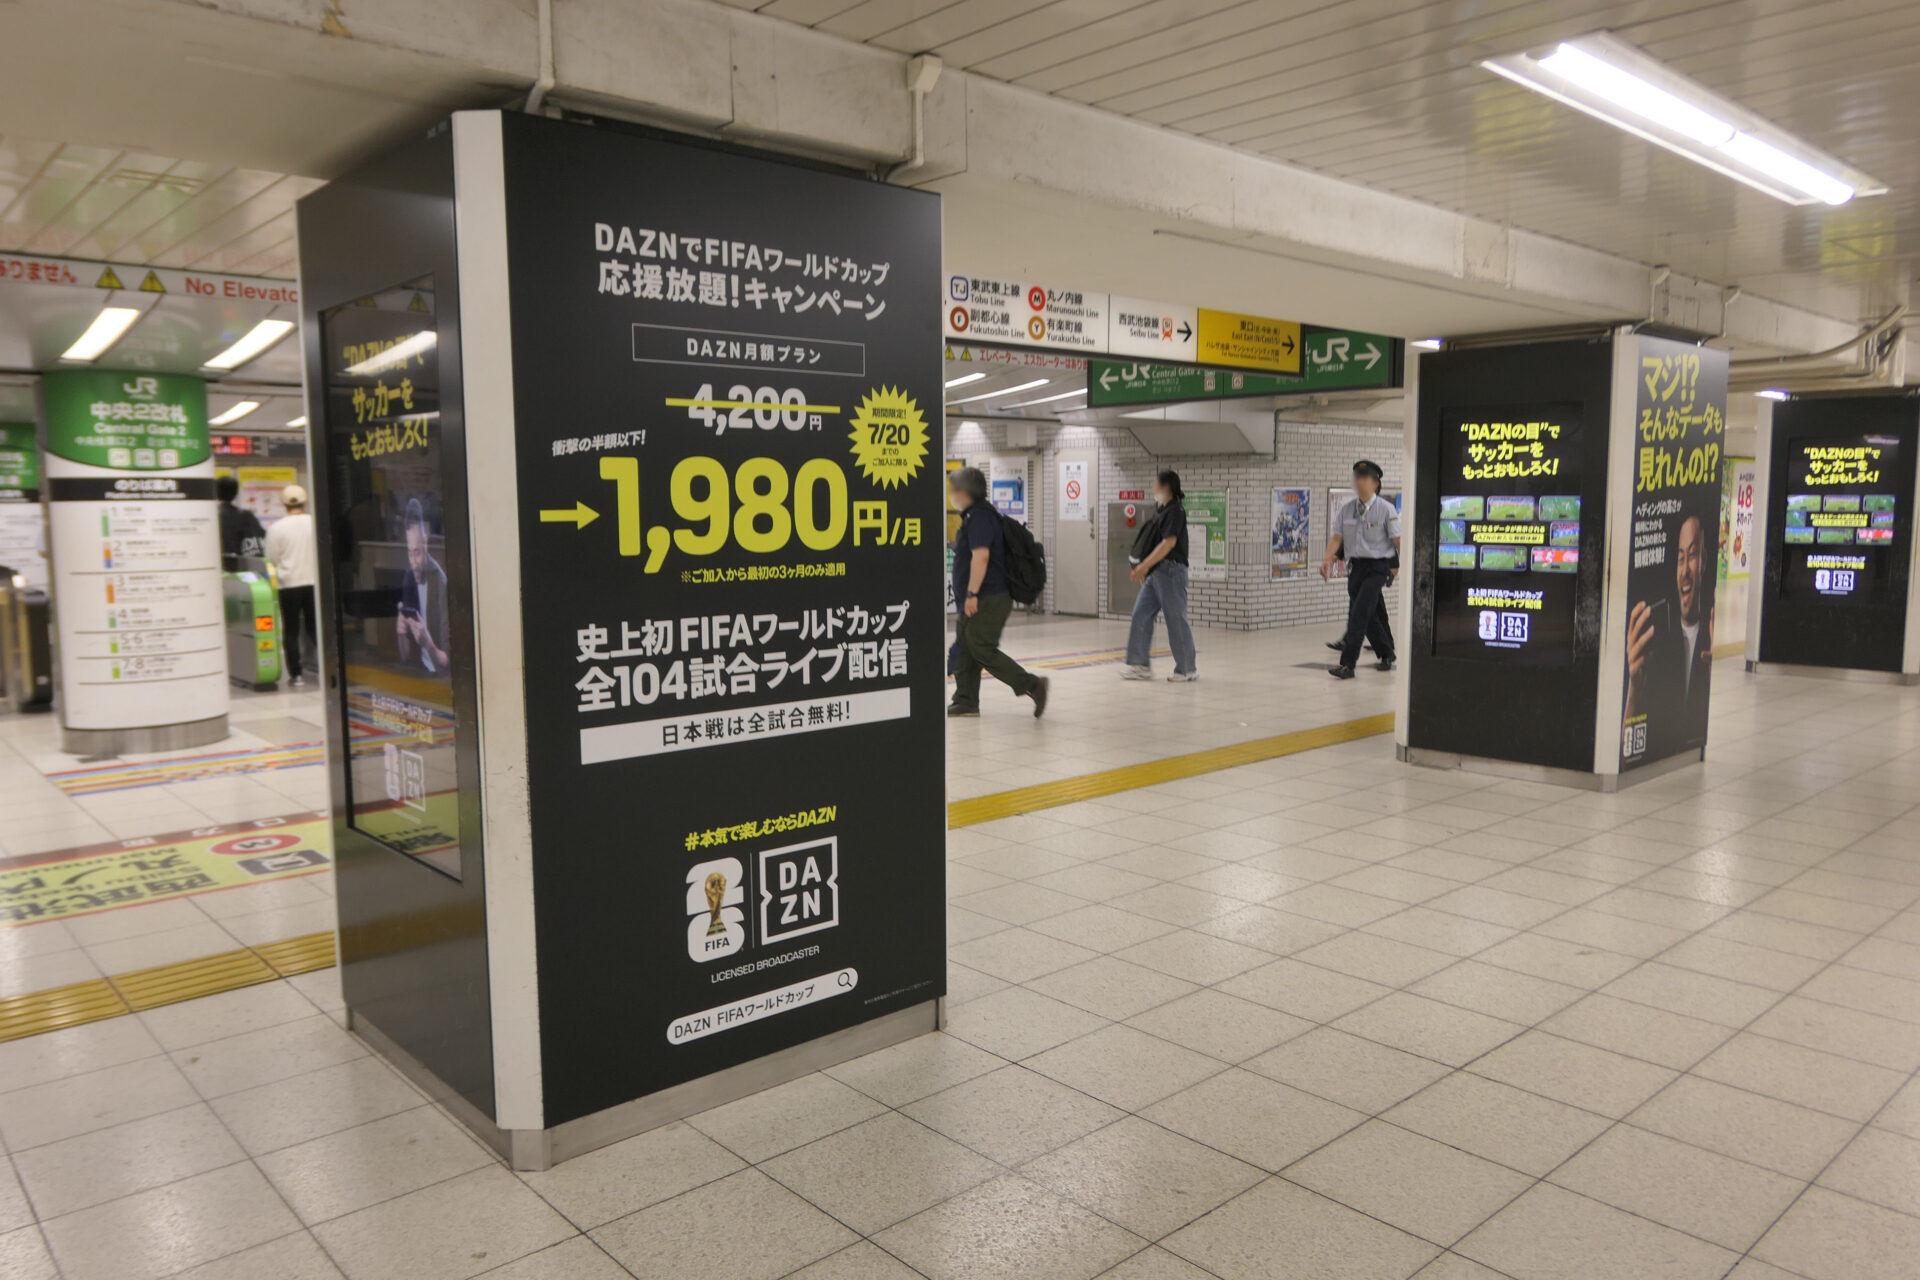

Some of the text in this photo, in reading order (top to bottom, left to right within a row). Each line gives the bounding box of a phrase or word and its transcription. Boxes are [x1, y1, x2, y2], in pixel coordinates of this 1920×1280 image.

[595, 222, 890, 286] DAZNでFIFAワールドカップ
[185, 277, 215, 296] No
[598, 259, 886, 320] 応援放題!キャンペーン
[971, 279, 1020, 297] 東武東上線
[971, 294, 1005, 306] Tobu Line
[1047, 289, 1083, 305] 丸ノ内線
[970, 309, 1010, 325] 副都心線
[1046, 303, 1099, 318] Marunouchi Line
[970, 324, 1025, 338] Fukutoshin Line
[1047, 318, 1083, 333] 有楽町線
[1119, 313, 1160, 329] 西武池袋線
[1047, 333, 1095, 345] Yurakucho Line
[1130, 327, 1159, 339] Seibu Line
[687, 338, 821, 365] DAZN月額プラン
[1312, 337, 1350, 365] JR
[1152, 367, 1177, 379] Central
[1179, 366, 1194, 377] Gate
[124, 377, 158, 395] JR
[352, 377, 414, 424] サッカーを
[687, 384, 823, 436] 4,200円
[90, 400, 188, 424] 中央2改札
[1639, 402, 1723, 442] そんなデータも
[94, 422, 187, 437] Central Gate 2
[350, 414, 428, 461] もっとおもしろく!
[867, 423, 910, 445] 7/20
[551, 429, 646, 457] 衝撃の半額以下!
[1468, 441, 1545, 463] サッカーを
[872, 459, 908, 467] ご加入に限る
[1462, 458, 1560, 480] もっとおもしろく!
[1637, 442, 1719, 493] 見れんの!?
[1809, 459, 1869, 474] サッカーを
[1804, 470, 1880, 486] もっとおもしろく!
[113, 541, 122, 552] 2
[119, 608, 127, 619] 4
[1507, 616, 1522, 627] DA
[1507, 627, 1522, 638] ZN
[575, 638, 909, 713] 全104試合ライブ配信
[662, 701, 851, 747] 日本戦は全試合無料!
[684, 805, 837, 851] #本気で楽しむならDAZN
[779, 856, 822, 891] DA
[0, 872, 220, 923] 西武池
[780, 889, 821, 925] ZN
[704, 936, 730, 952] FIFA
[711, 945, 820, 984] LICENSED BROADCASTER
[674, 984, 815, 1039] DAZN FIFAワールドカップ
